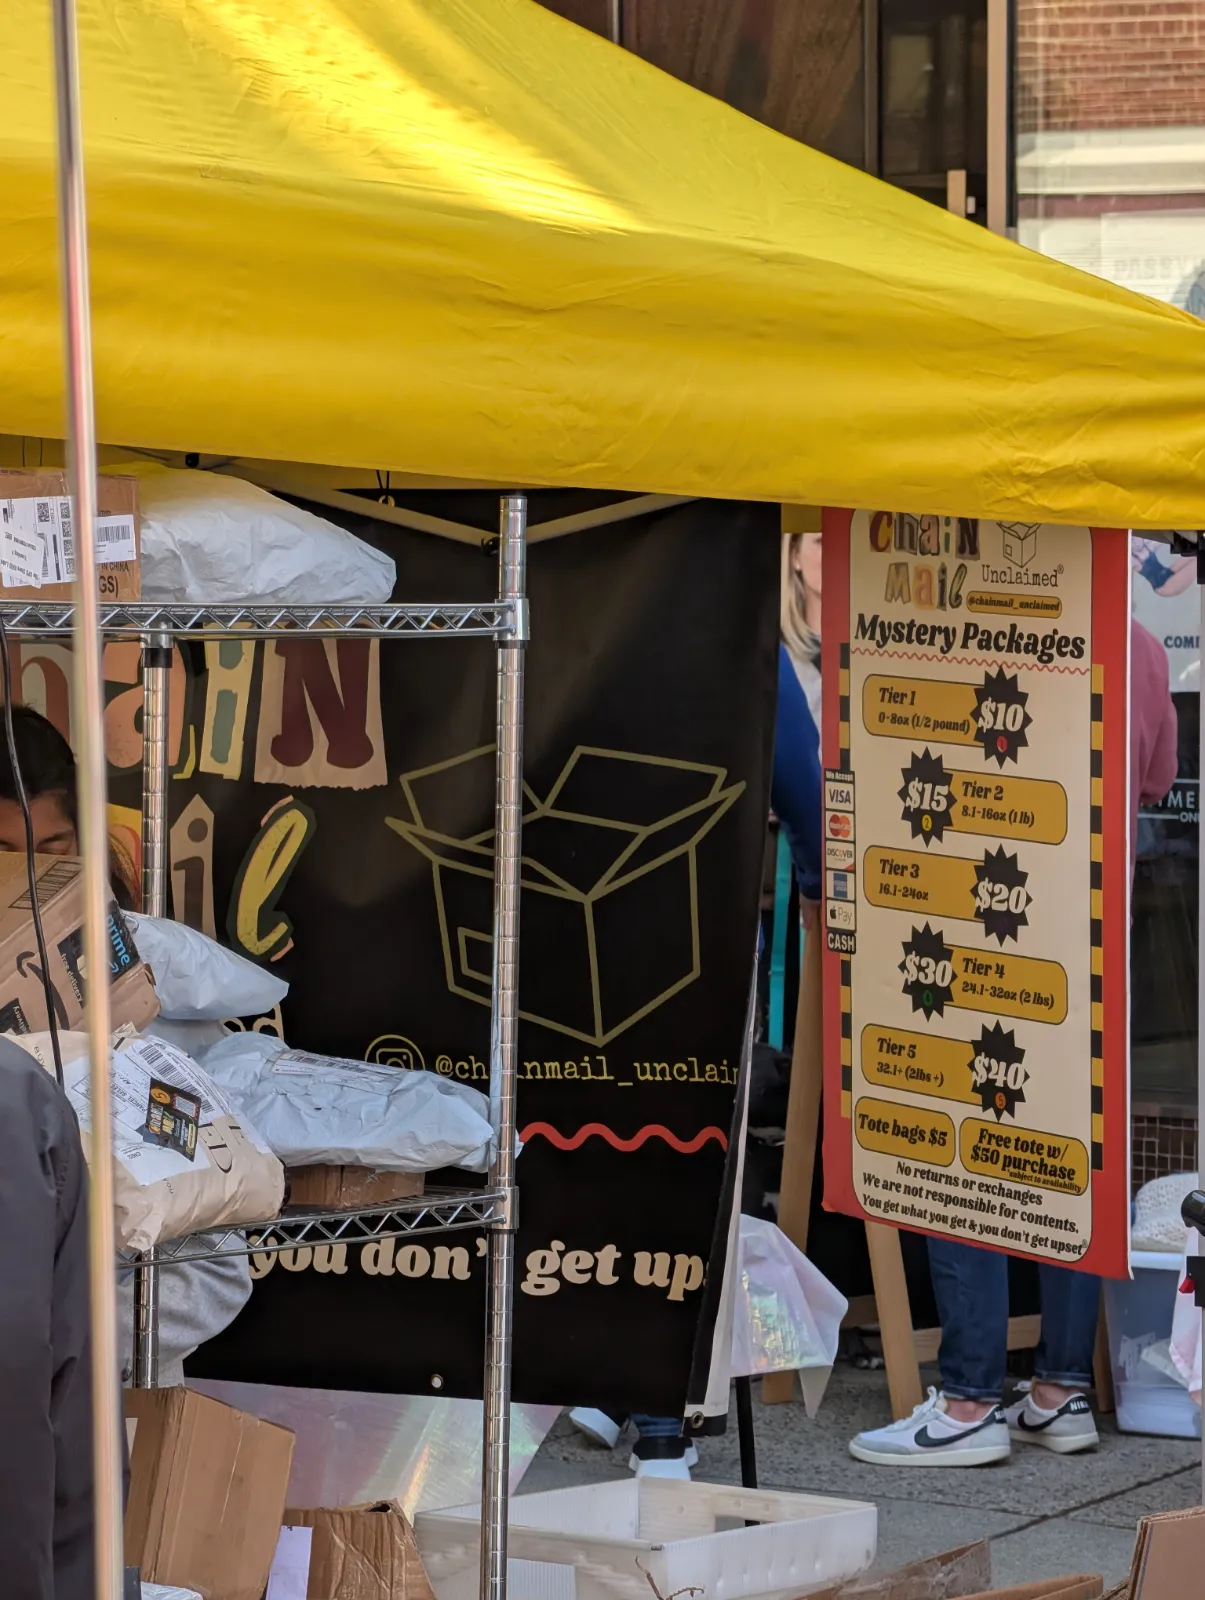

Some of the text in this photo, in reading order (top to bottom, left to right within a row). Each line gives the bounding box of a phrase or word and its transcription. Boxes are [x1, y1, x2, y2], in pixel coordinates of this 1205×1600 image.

[968, 595, 1060, 612] @chainmail_unclaimed
[854, 613, 1086, 664] Mystery Packages
[879, 687, 916, 706] Tier 1
[878, 711, 970, 735] 0-8oz (1/2 pound)
[978, 697, 1024, 733] $10
[828, 788, 851, 805] VISA
[906, 777, 949, 812] $15
[962, 781, 1004, 801] Tier 2
[961, 805, 1035, 828] 8.1-16oz (1 lb)
[880, 859, 920, 879] Tier 3
[879, 882, 929, 900] 16.1-24oz
[975, 877, 1026, 914] $20
[837, 907, 853, 923] Pay
[828, 932, 855, 951] CASH
[61, 953, 83, 1002] free delivery
[903, 951, 951, 987] $30
[962, 958, 1005, 979] Tier 4
[962, 981, 1055, 1010] 24.1-32oz (2 lbs)
[877, 1037, 917, 1059] Tier 5
[435, 1054, 738, 1086] @chnmail_unclai
[877, 1062, 903, 1078] 32.1+
[972, 1052, 1024, 1090] $40
[859, 1114, 948, 1147] Tote bags $5
[978, 1128, 1069, 1162] Free tote w/
[971, 1143, 1076, 1181] $50 purchase
[896, 1161, 1043, 1206] No returns or exchanges
[1034, 1176, 1041, 1184] to
[1042, 1178, 1081, 1193] availability
[863, 1172, 1079, 1234] We are not responsible for contents.
[863, 1194, 882, 1209] You
[883, 1199, 900, 1213] get
[901, 1204, 928, 1220] what
[928, 1211, 948, 1224] you
[949, 1215, 967, 1229] get
[968, 1219, 977, 1232] &
[978, 1223, 999, 1235] you
[1000, 1226, 1030, 1243] don't
[1030, 1233, 1049, 1248] get
[248, 1230, 710, 1302] you don' get up
